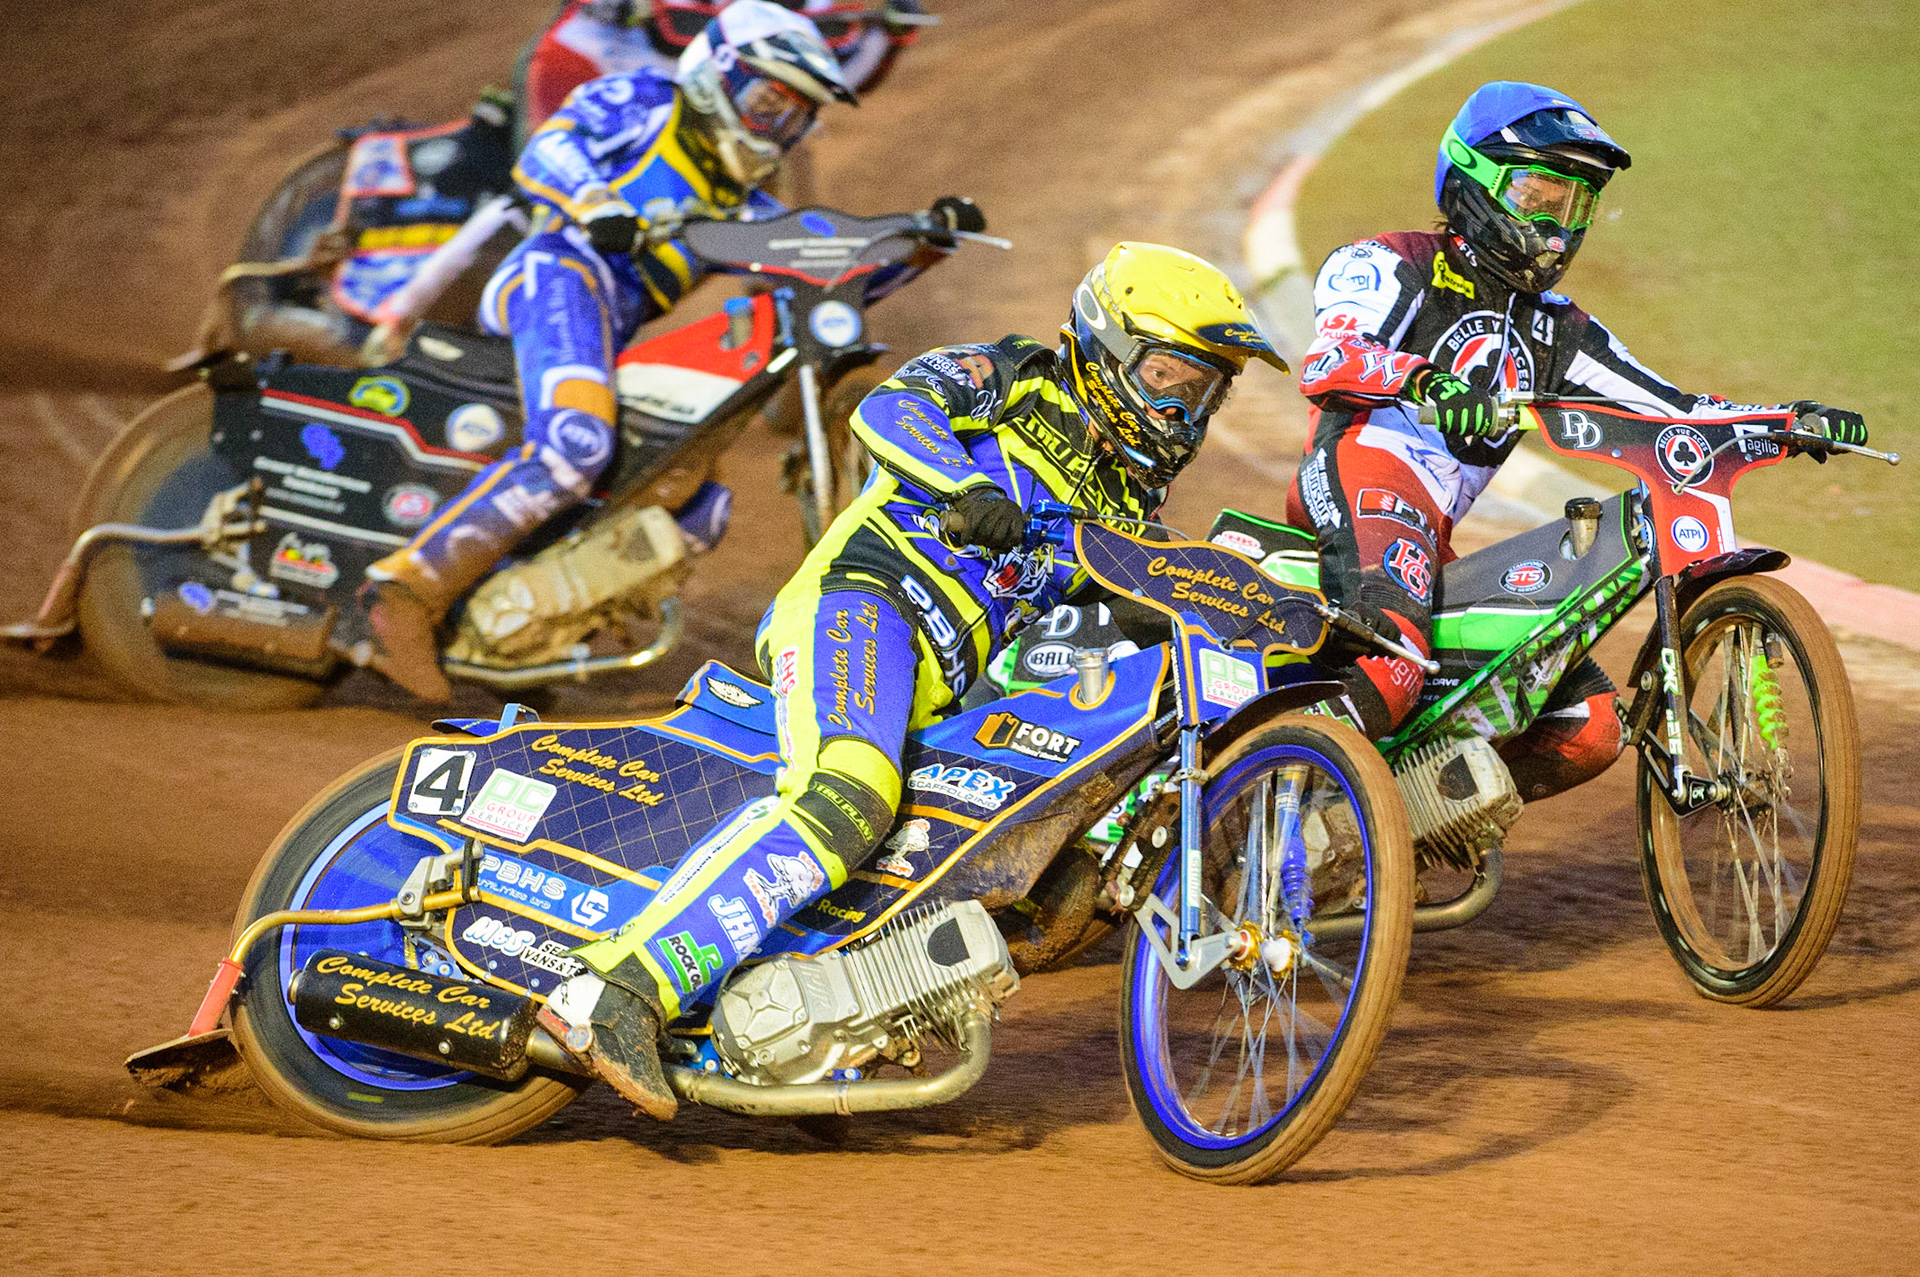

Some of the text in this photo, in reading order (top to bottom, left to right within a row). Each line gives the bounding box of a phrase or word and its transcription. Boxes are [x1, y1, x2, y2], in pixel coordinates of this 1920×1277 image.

[1447, 319, 1485, 351] BELLE
[1534, 314, 1548, 341] 4
[1510, 347, 1529, 389] ACES
[1025, 413, 1072, 460] TRU
[1117, 426, 1141, 446] Ltd
[1120, 412, 1140, 432] Car
[1660, 427, 1708, 452] BELLE VUE ACES
[1747, 439, 1780, 456] agilia
[1678, 527, 1701, 540] ATPI
[1147, 556, 1275, 605] Complete Car
[1508, 571, 1541, 581] STS
[1171, 581, 1286, 635] Services Ltd
[826, 609, 853, 730] Complete Car
[854, 601, 879, 716] Services Ltd
[1205, 686, 1245, 702] SERVIC
[1214, 680, 1257, 697] GROUP
[1015, 722, 1080, 755] FORT
[531, 734, 660, 784] Complete Car
[414, 755, 466, 812] 4
[538, 758, 666, 807] Services Ltd
[909, 779, 998, 809] SCAFFOLDING
[914, 764, 1014, 801] APEX
[470, 808, 530, 833] SERVICES
[486, 802, 537, 823] GROUP
[816, 784, 874, 842] TRU PLANT
[478, 854, 567, 900] PBHS
[817, 899, 867, 923] Racing
[524, 949, 558, 969] VANS
[668, 936, 698, 973] ROCK
[315, 955, 491, 1009] Complete Car
[334, 983, 500, 1040] Services Ltd
